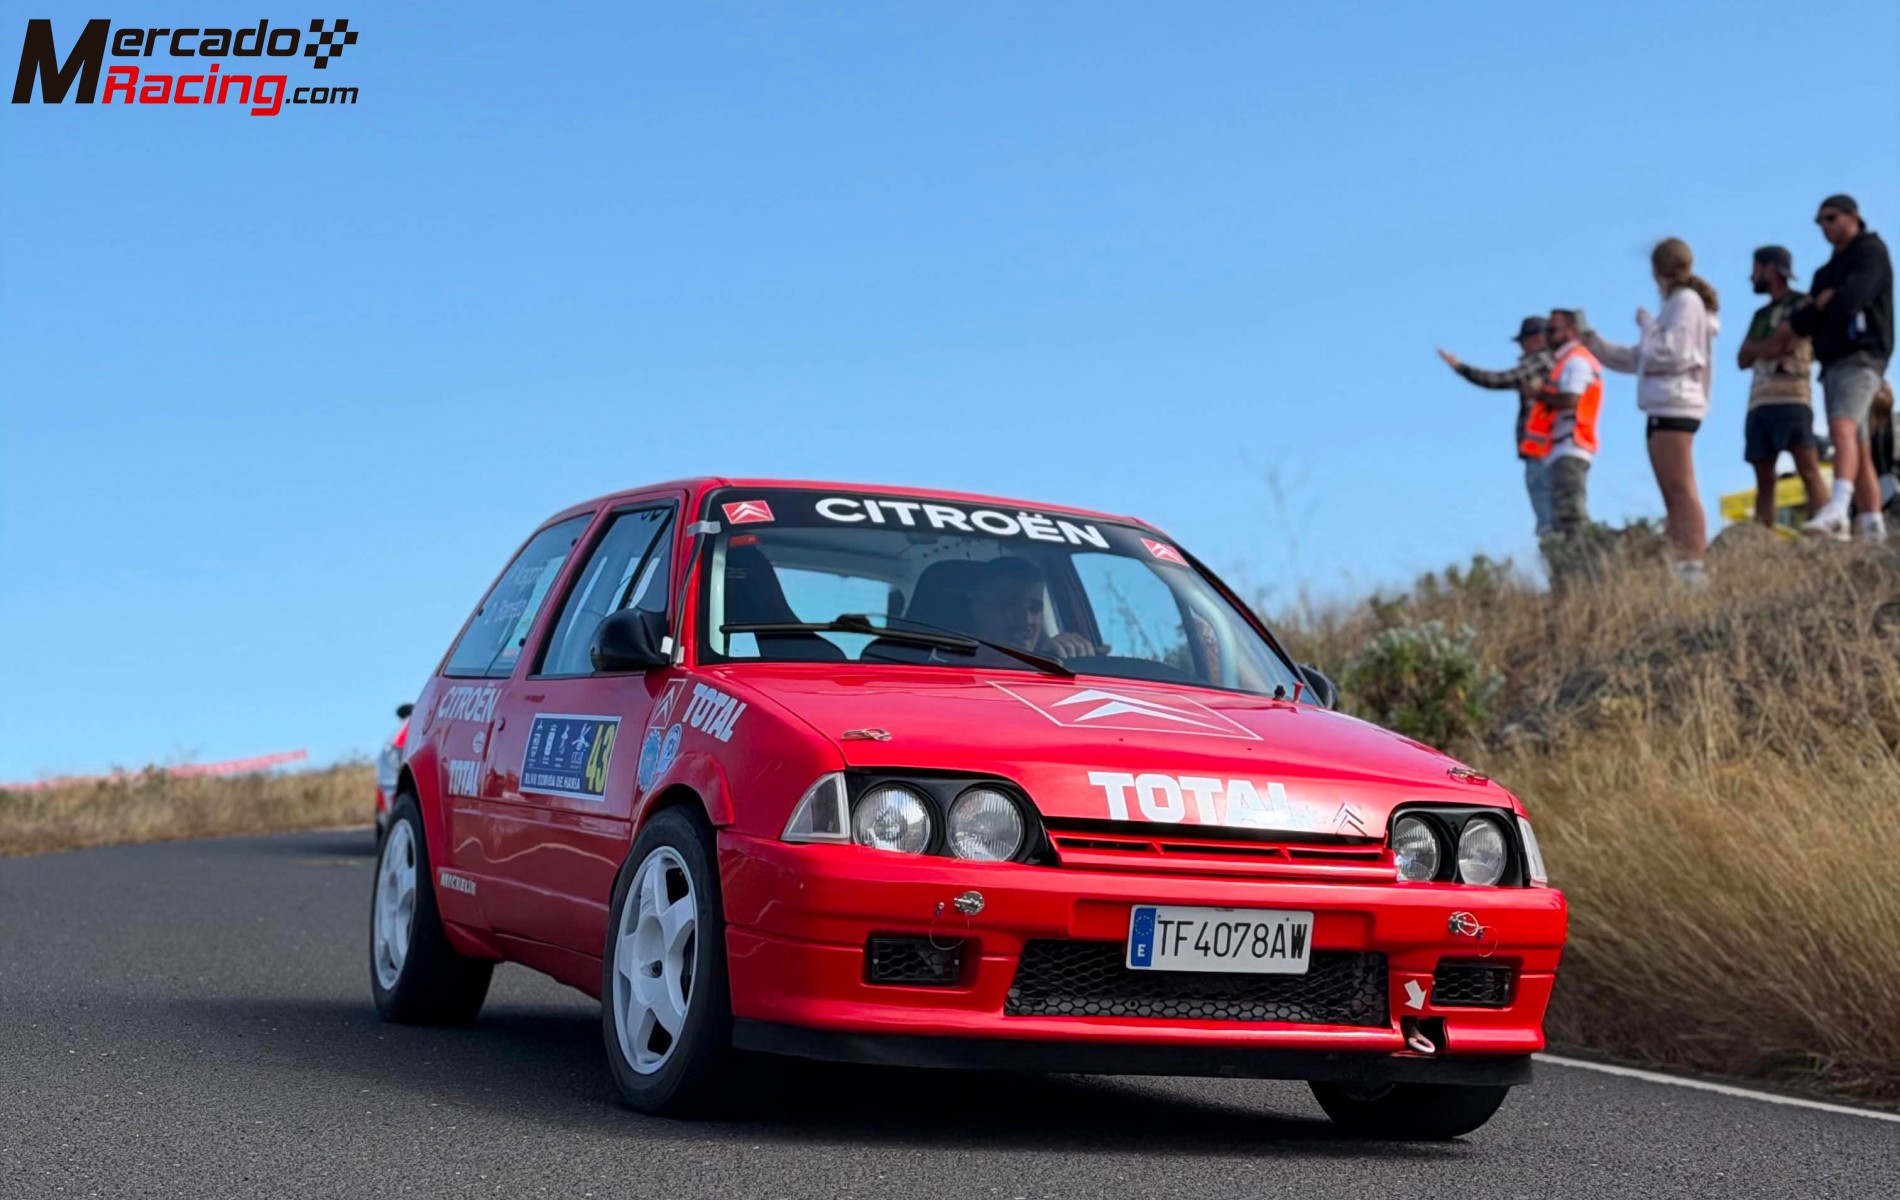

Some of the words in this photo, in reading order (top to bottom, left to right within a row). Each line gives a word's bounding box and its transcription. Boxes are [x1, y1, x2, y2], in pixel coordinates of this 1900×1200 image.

[815, 497, 1110, 549] CITROËN
[438, 682, 502, 723] CITROËN
[682, 682, 747, 742] TOTAL
[448, 760, 480, 797] TOTAL
[585, 724, 615, 792] 43
[1088, 771, 1310, 829] TOTAL
[440, 871, 476, 897] MICHELIN
[1137, 944, 1146, 957] E
